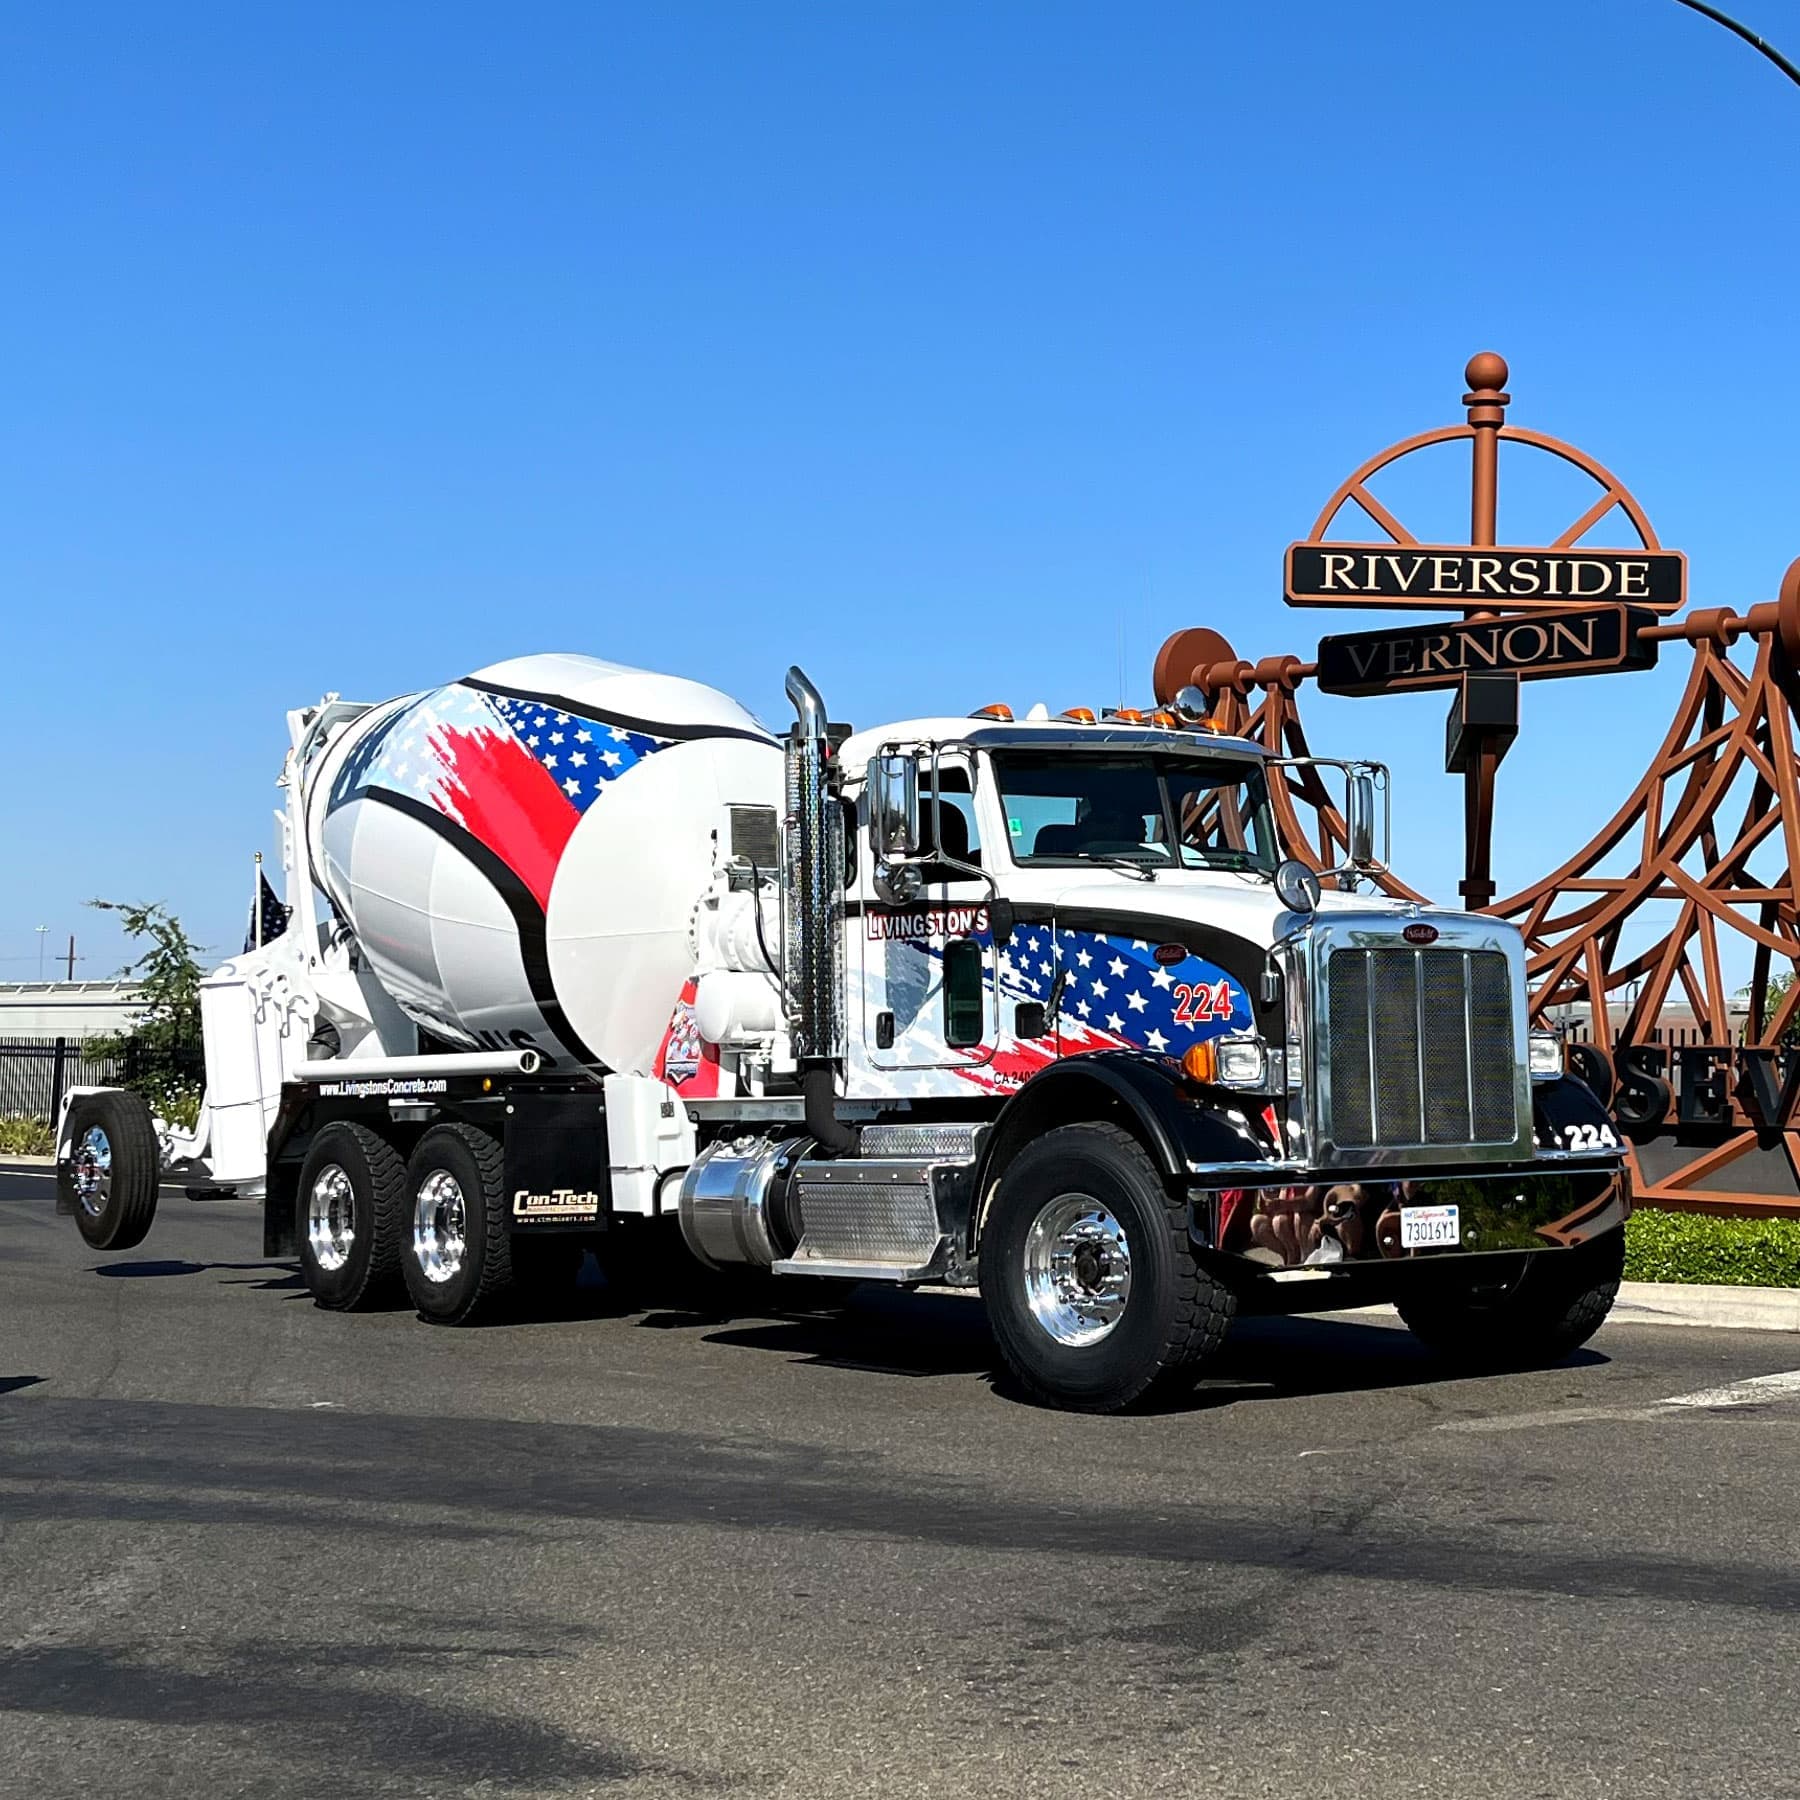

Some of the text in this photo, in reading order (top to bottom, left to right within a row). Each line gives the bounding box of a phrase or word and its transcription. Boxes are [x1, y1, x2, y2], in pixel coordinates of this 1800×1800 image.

[1319, 554, 1650, 597] RIVERSIDE
[1345, 618, 1598, 678] VERNON
[866, 907, 989, 939] LIVINGSTON'S
[1173, 982, 1233, 1021] 224
[319, 1079, 447, 1099] www.LivingstonsConcrete.com
[993, 1072, 1010, 1085] CA
[1564, 1124, 1618, 1151] 224
[513, 1189, 598, 1215] Con-Tech
[1406, 1221, 1456, 1241] 73016Y1
